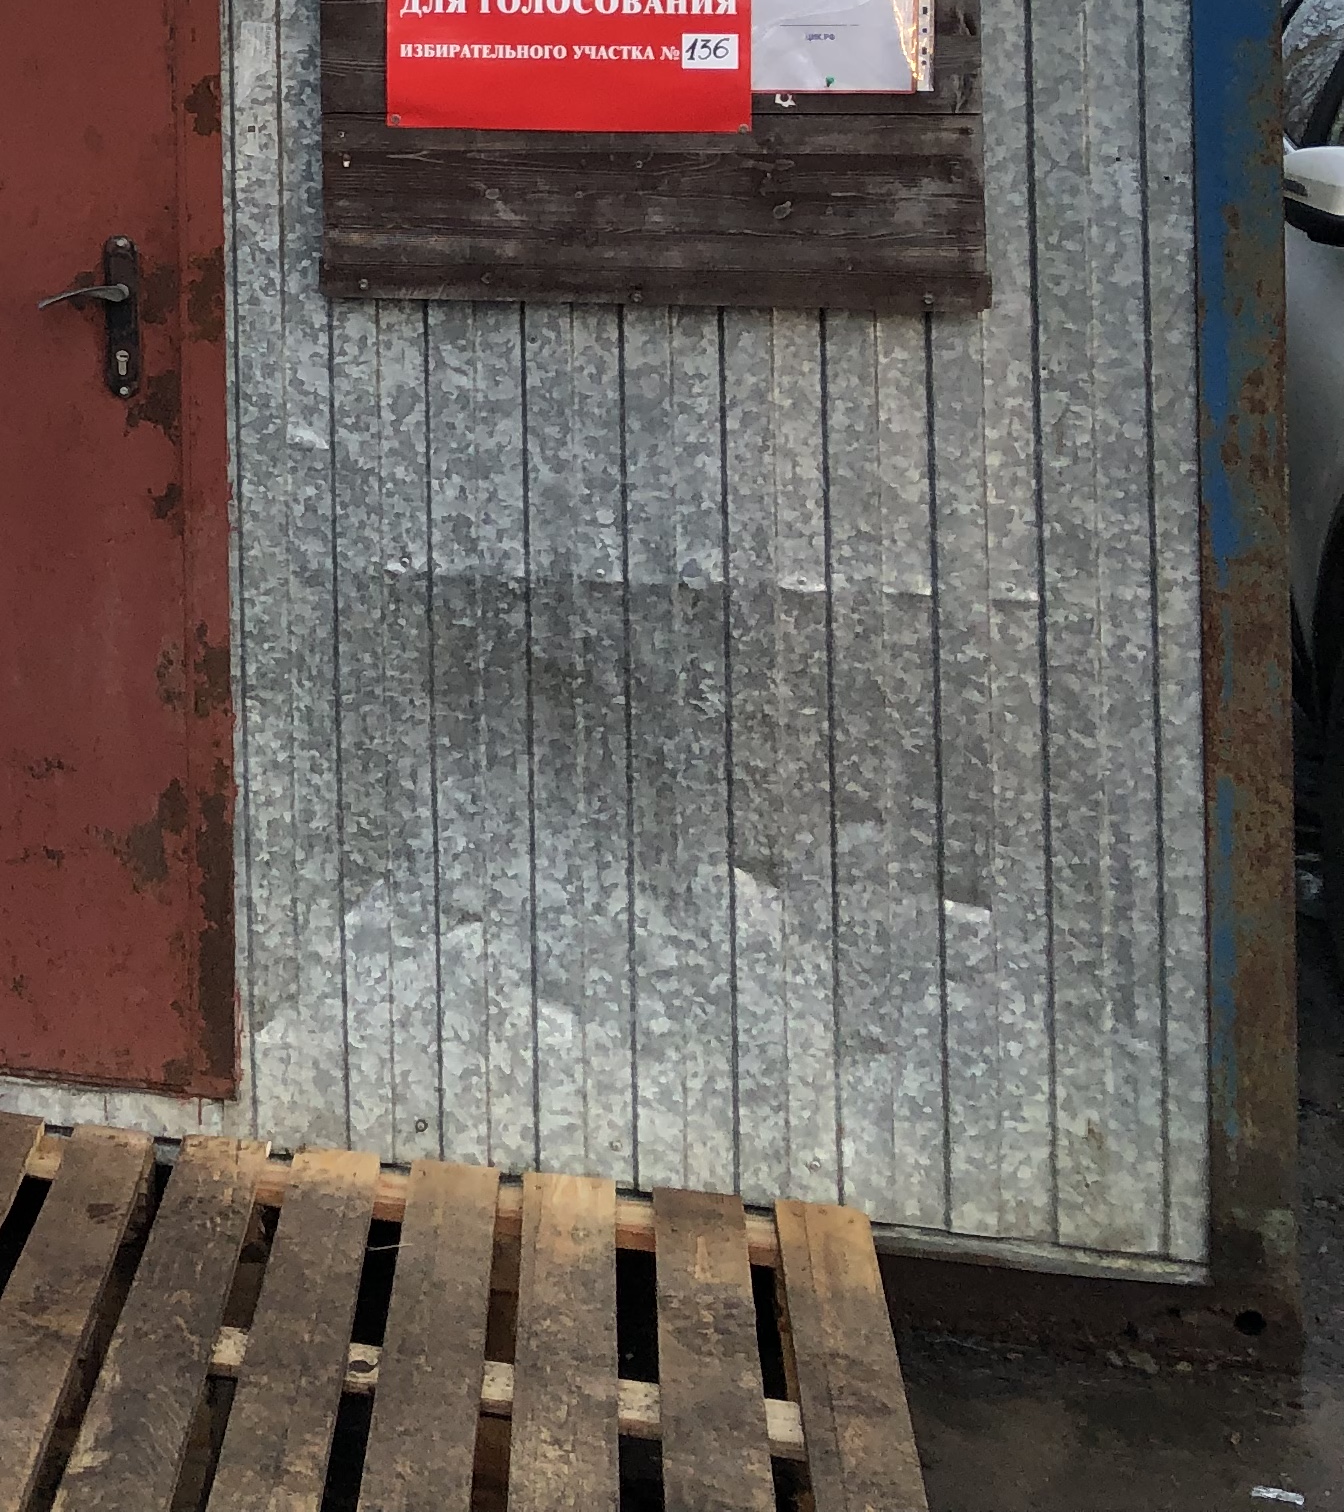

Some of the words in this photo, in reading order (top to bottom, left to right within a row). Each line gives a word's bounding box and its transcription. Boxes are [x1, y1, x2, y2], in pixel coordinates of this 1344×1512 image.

[399, 43, 568, 61] ИЗБИРАТЕЛЬНОГО
[572, 43, 655, 61] УЧАСТКА
[659, 45, 681, 61] №
[685, 37, 731, 62] 136
